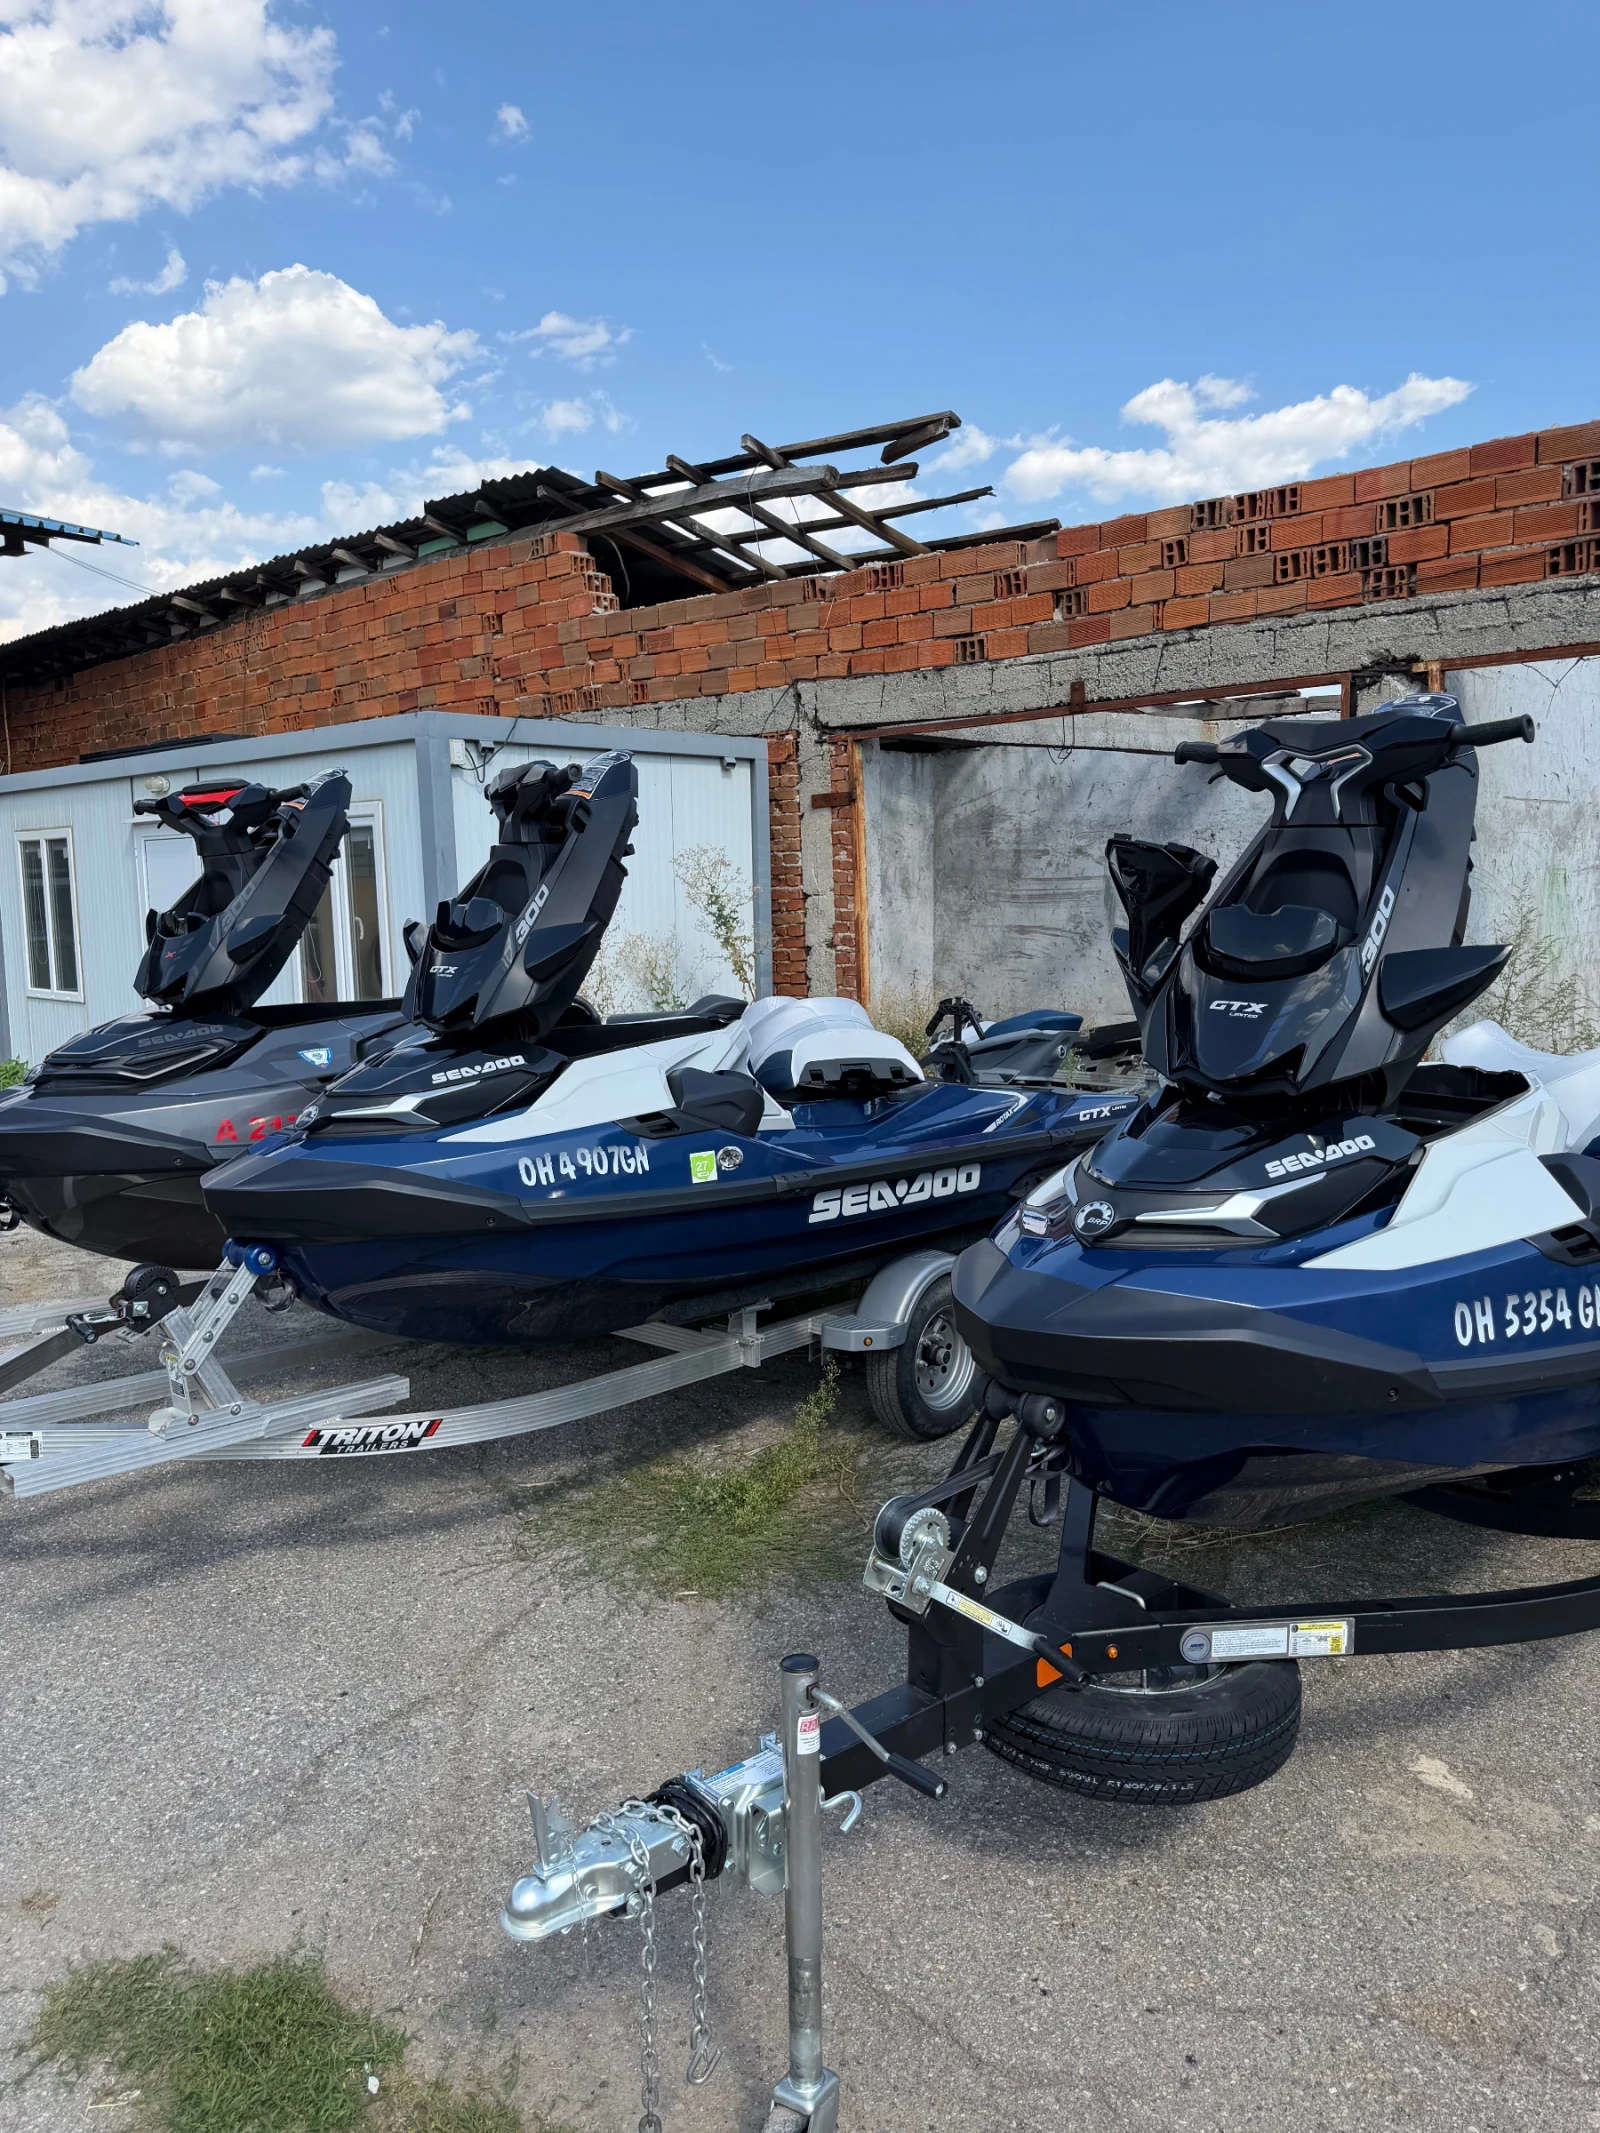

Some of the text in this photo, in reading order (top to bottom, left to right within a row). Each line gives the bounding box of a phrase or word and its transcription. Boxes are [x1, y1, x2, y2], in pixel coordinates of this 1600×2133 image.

[515, 884, 550, 945] 300
[1361, 884, 1396, 974] 300
[429, 965, 459, 974] GTX
[1209, 1000, 1269, 1014] GTX
[1079, 1105, 1111, 1122] GTX
[215, 1114, 298, 1143] A 21
[518, 1152, 556, 1187] OH
[695, 1160, 708, 1172] 27
[1086, 1216, 1108, 1226] BRP
[1454, 1295, 1496, 1347] OH
[317, 1420, 431, 1446] TRITON
[337, 1440, 409, 1453] TRAILERS
